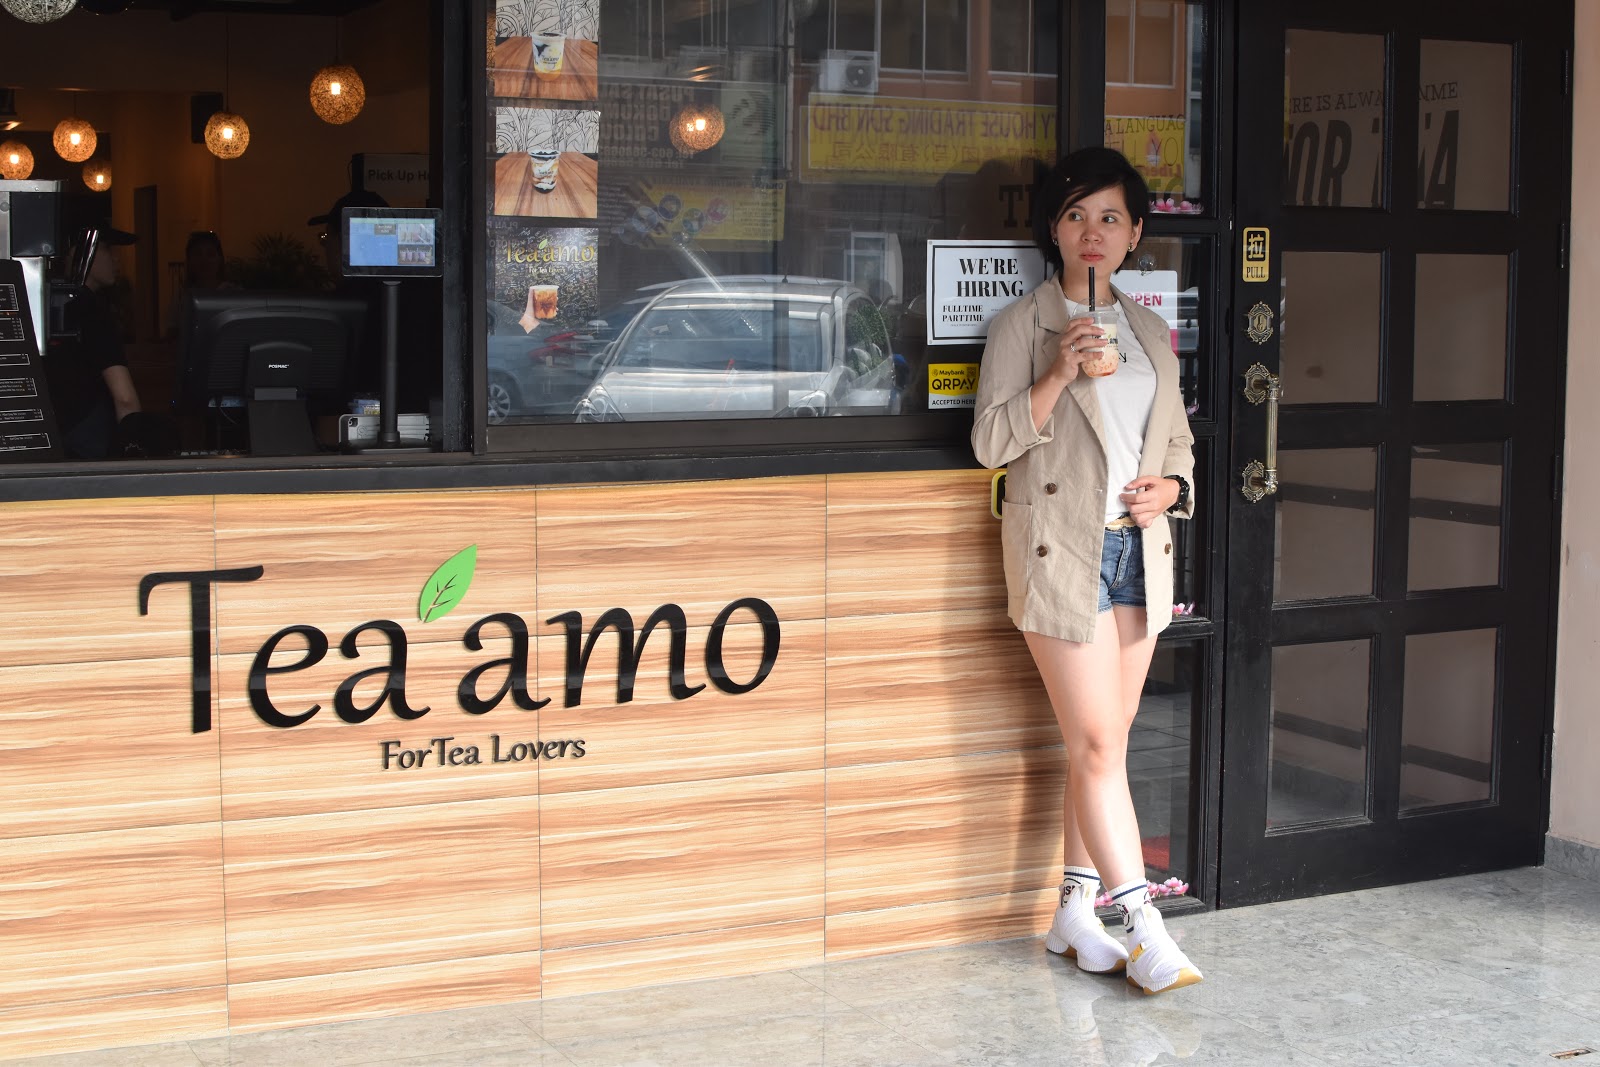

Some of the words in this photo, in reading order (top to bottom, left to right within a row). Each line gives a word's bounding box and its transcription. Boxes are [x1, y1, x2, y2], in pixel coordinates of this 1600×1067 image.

[1288, 96, 1313, 115] RE
[1316, 94, 1332, 112] IS
[1116, 114, 1184, 134] LANGUAG
[368, 169, 393, 181] Pick
[398, 169, 415, 183] Up
[1247, 233, 1265, 259] 拉
[959, 257, 1019, 275] WE'RE
[1246, 266, 1266, 278] PULL
[956, 280, 1024, 297] HIRING
[942, 304, 984, 313] FULLTIME
[942, 314, 985, 322] PARTTIME
[939, 369, 965, 378] Maybank
[932, 378, 976, 391] QRPAY
[380, 739, 433, 770] For
[431, 736, 482, 767] Tea
[489, 733, 586, 764] Lovers
